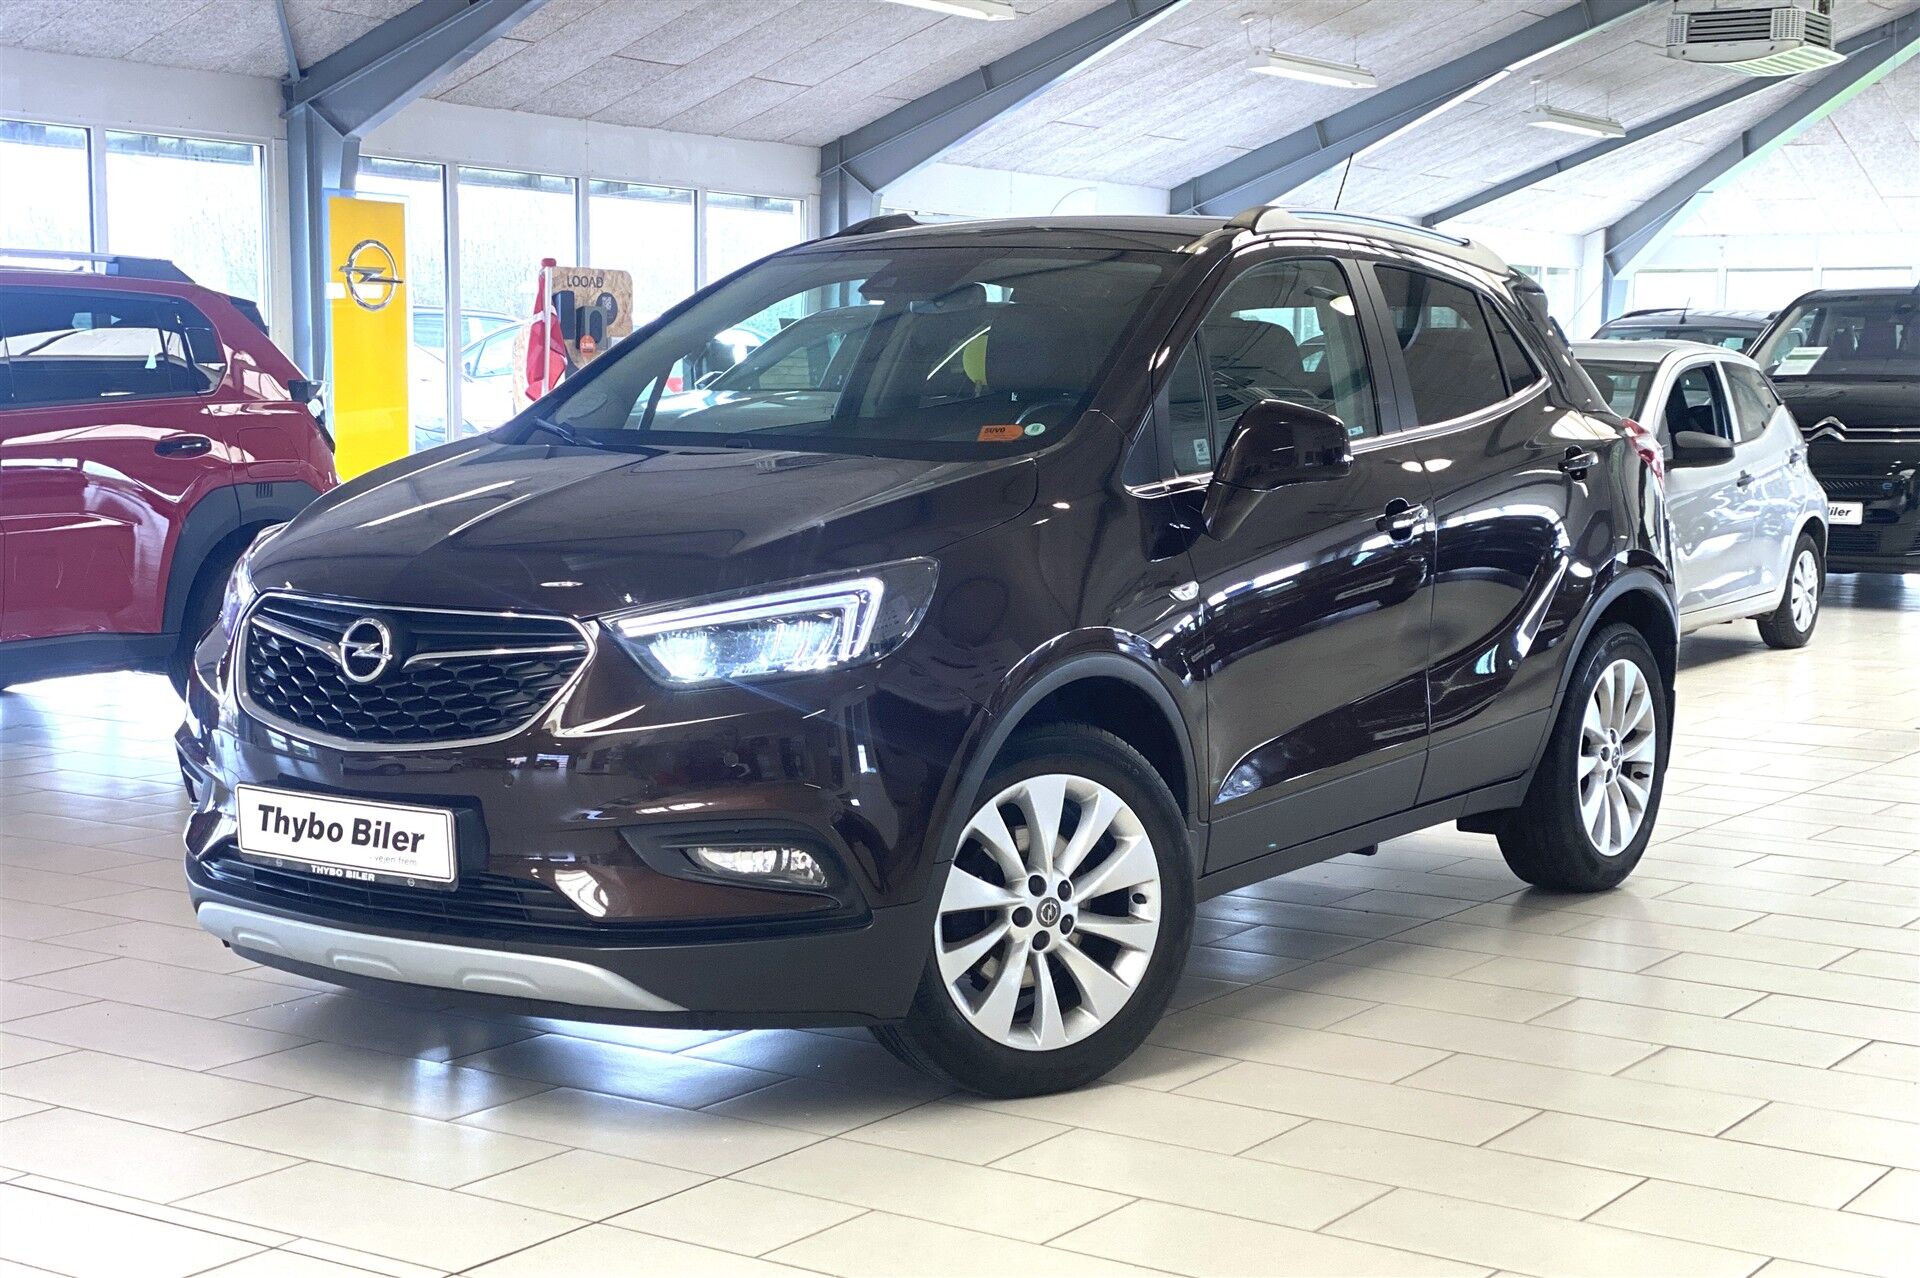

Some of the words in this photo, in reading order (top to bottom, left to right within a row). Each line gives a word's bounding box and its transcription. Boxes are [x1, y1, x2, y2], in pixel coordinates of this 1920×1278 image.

[1828, 506, 1852, 516] iler
[258, 804, 344, 843] Thybo
[351, 818, 425, 853] Biler
[311, 864, 344, 877] THYBO
[345, 870, 376, 882] BILER
